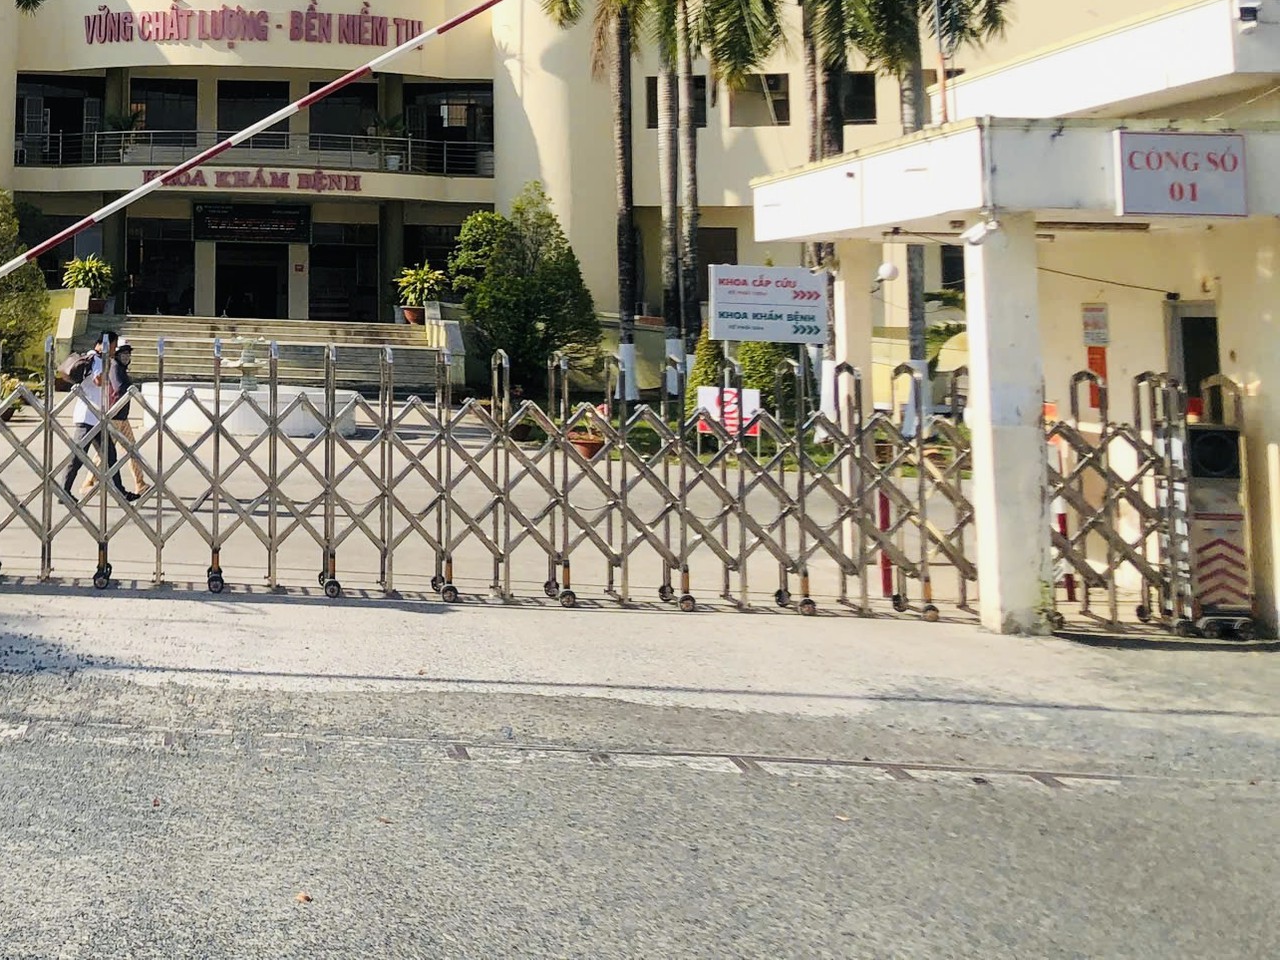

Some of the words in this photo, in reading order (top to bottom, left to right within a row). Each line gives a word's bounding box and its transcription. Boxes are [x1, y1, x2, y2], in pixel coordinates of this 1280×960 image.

[85, 5, 133, 44] VỮNG
[214, 167, 290, 188] KHÁM
[296, 165, 362, 192] BỆNH
[1168, 181, 1199, 202] 01
[718, 277, 749, 287] KHOA
[752, 274, 772, 288] CẤP
[775, 277, 798, 289] CỨU
[718, 311, 749, 320] KHOA
[752, 309, 783, 321] KHÁM
[786, 310, 816, 325] BỆNH
